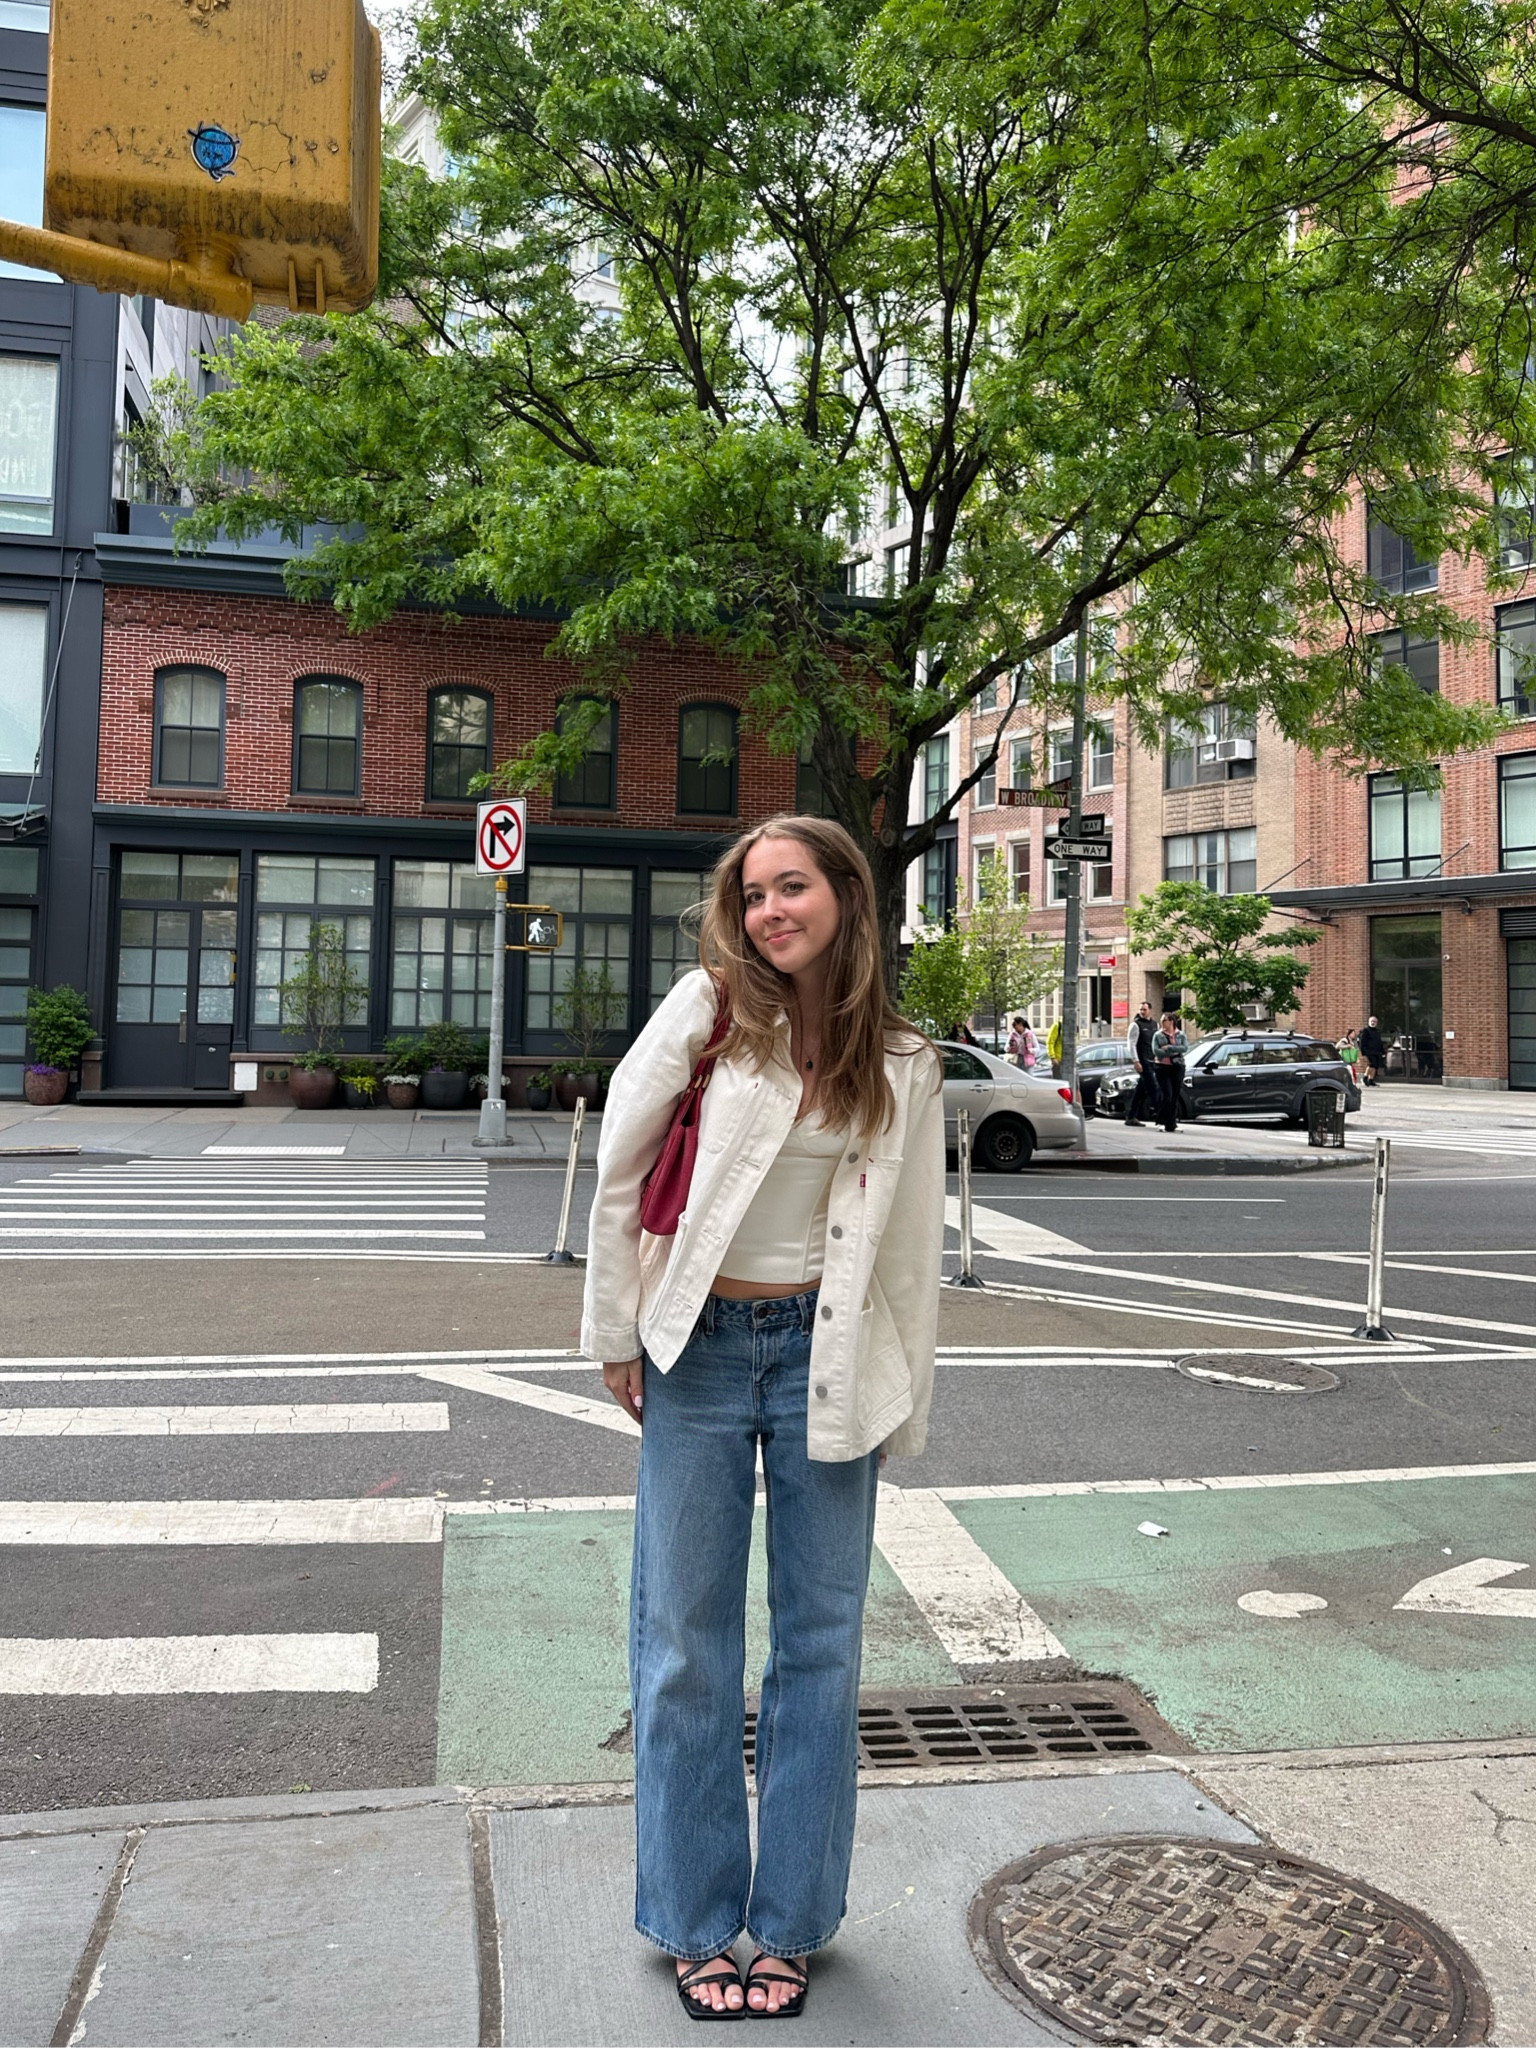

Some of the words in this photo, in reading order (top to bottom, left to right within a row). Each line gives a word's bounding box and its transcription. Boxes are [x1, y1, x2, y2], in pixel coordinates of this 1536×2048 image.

[1001, 791, 1009, 803] W
[1014, 792, 1066, 807] BROADWY
[1084, 822, 1098, 831] WAY
[1054, 844, 1073, 854] ONE
[1082, 846, 1103, 855] WAY
